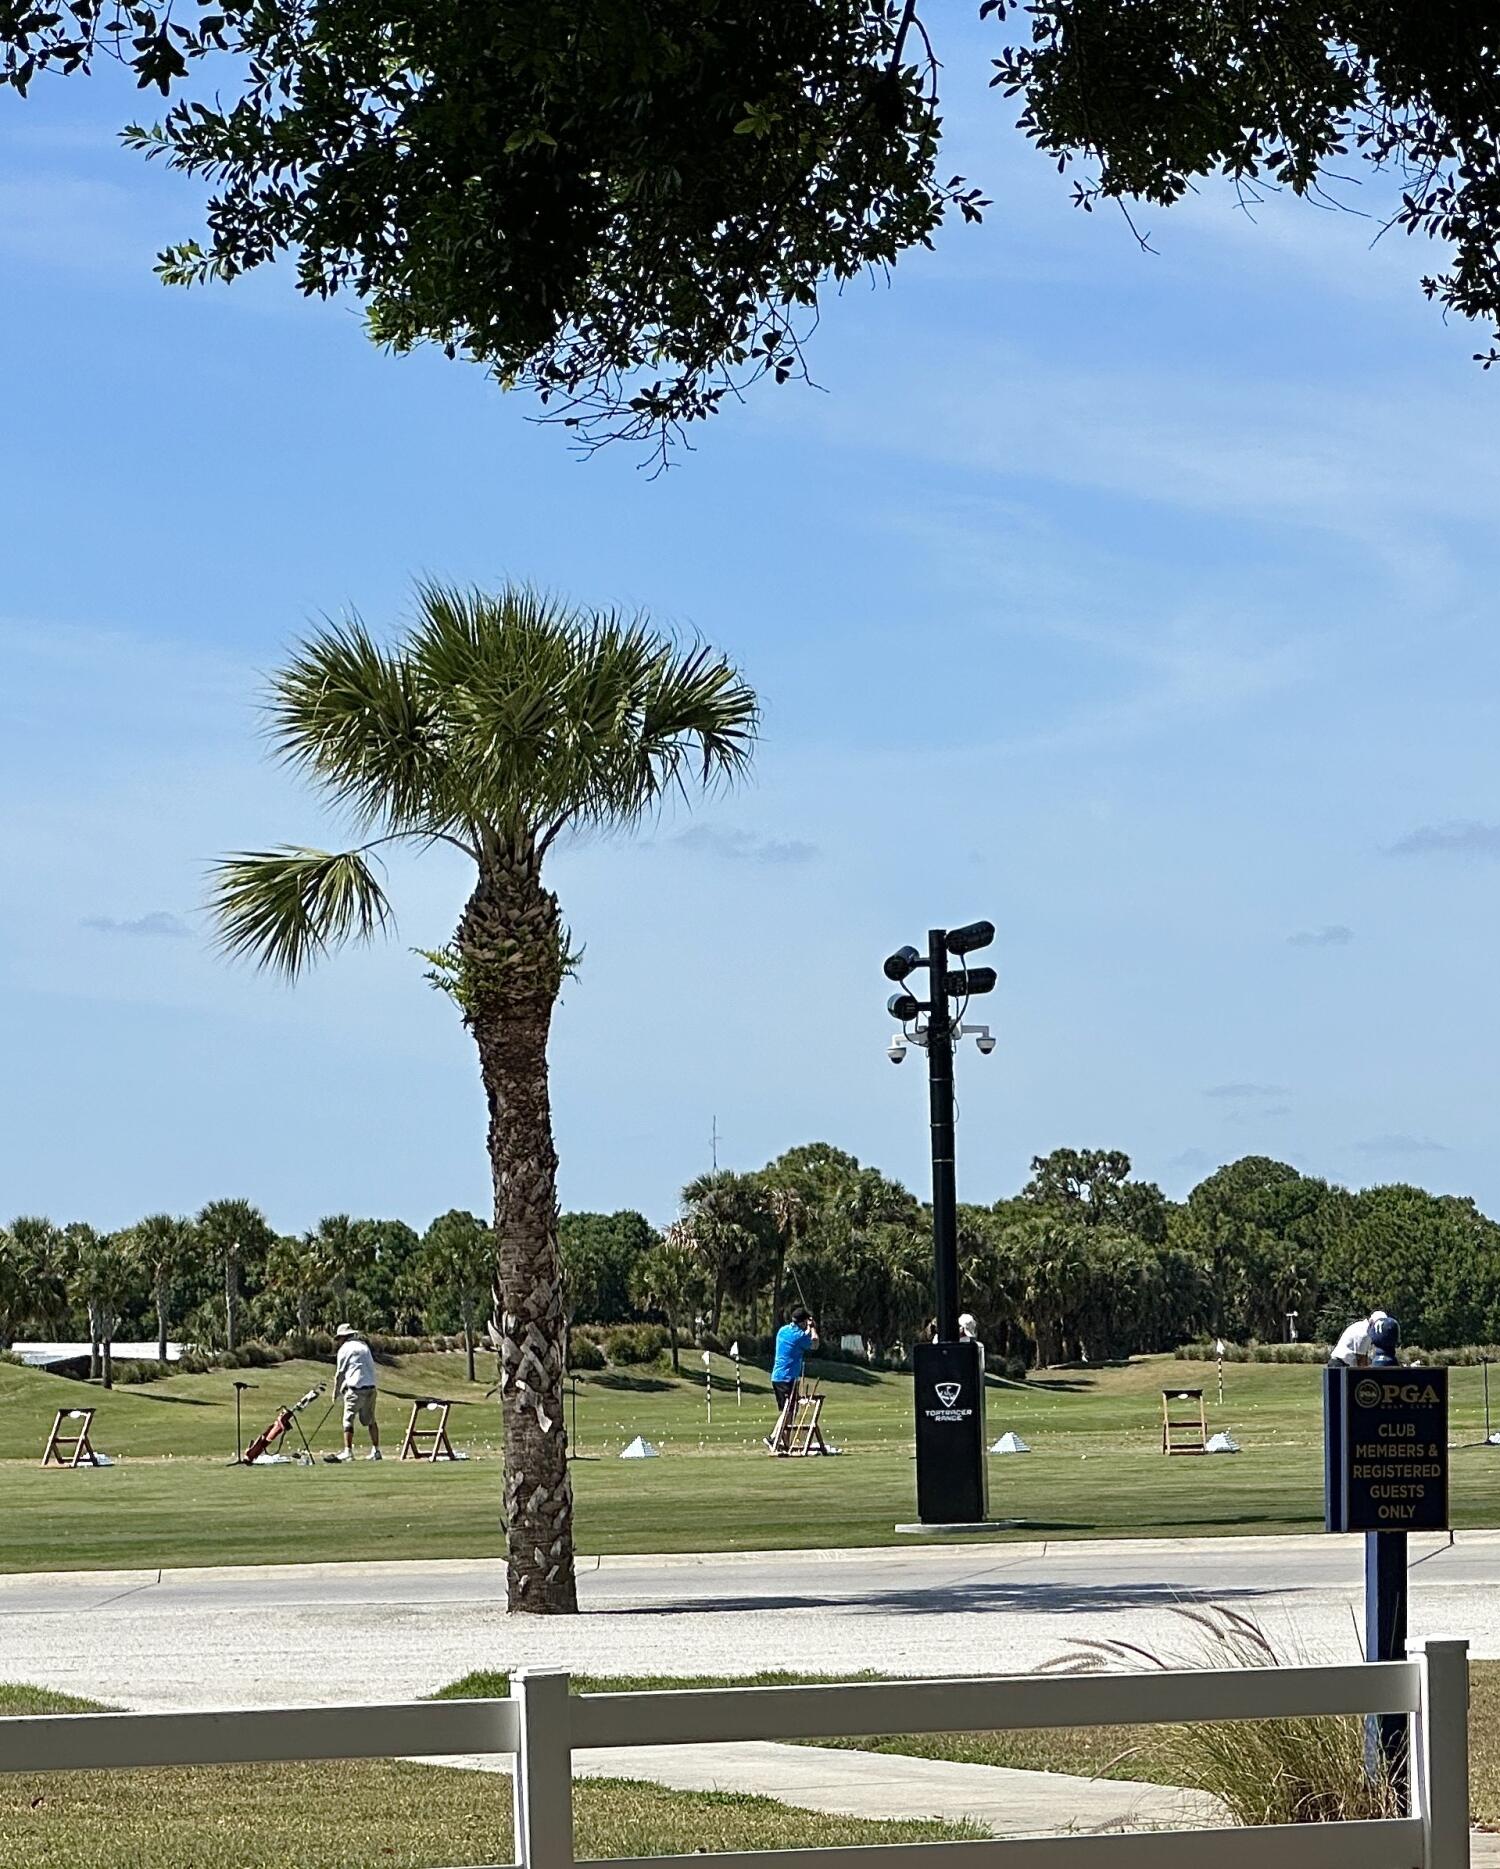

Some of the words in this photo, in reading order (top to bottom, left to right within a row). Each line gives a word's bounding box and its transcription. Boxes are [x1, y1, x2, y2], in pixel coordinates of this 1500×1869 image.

[1381, 1384, 1440, 1403] PGA
[925, 1409, 972, 1417] TOPTRACER
[1378, 1423, 1416, 1437] CLUB
[1356, 1443, 1424, 1458] MEMBERS
[1428, 1443, 1438, 1457] &
[1353, 1464, 1441, 1478] REGISTERED
[1370, 1484, 1425, 1498] GUESTS
[1378, 1505, 1416, 1519] ONLY
